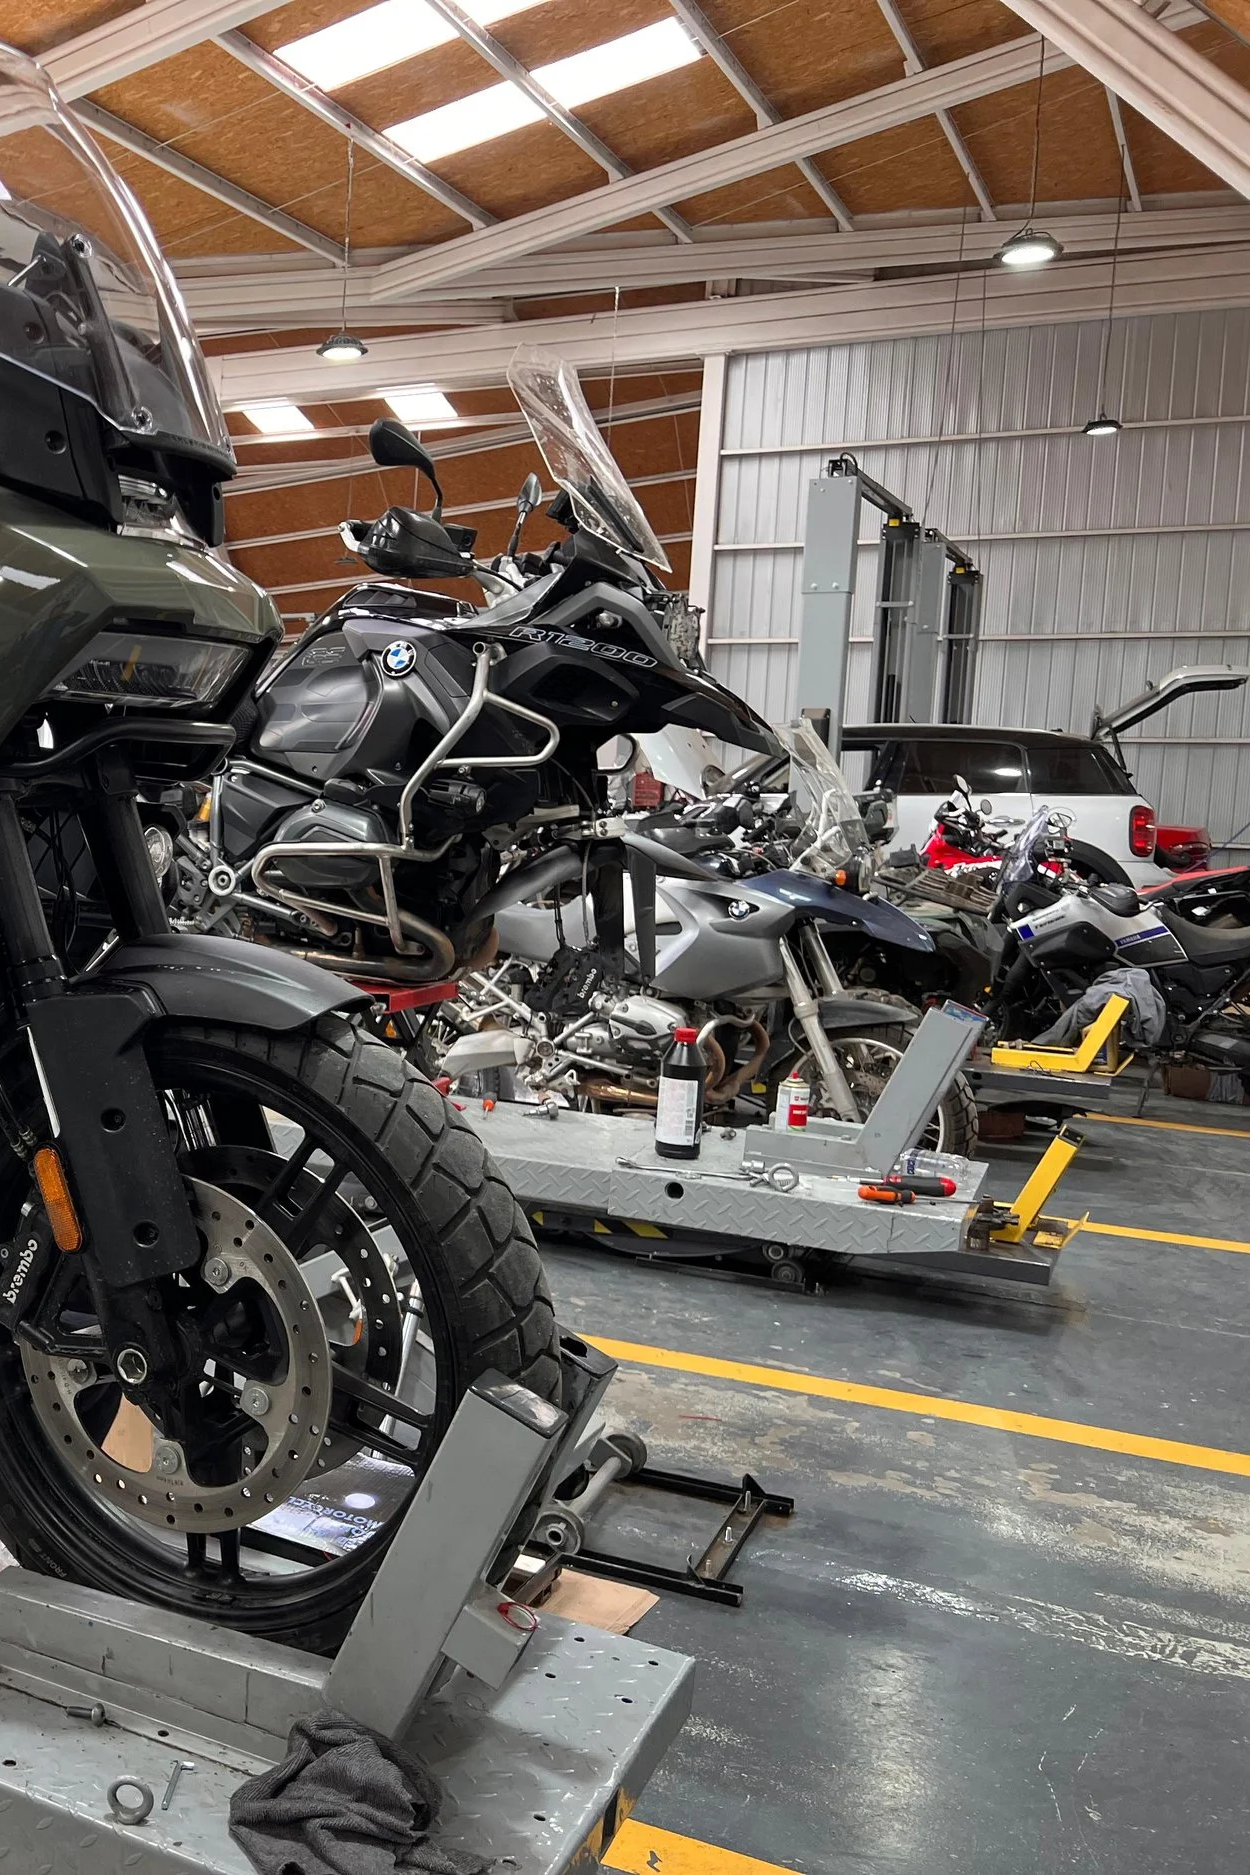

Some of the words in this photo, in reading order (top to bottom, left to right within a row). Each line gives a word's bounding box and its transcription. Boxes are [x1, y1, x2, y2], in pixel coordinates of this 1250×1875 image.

[509, 626, 657, 667] R1200
[576, 968, 597, 999] brembo
[2, 1239, 38, 1304] brembo
